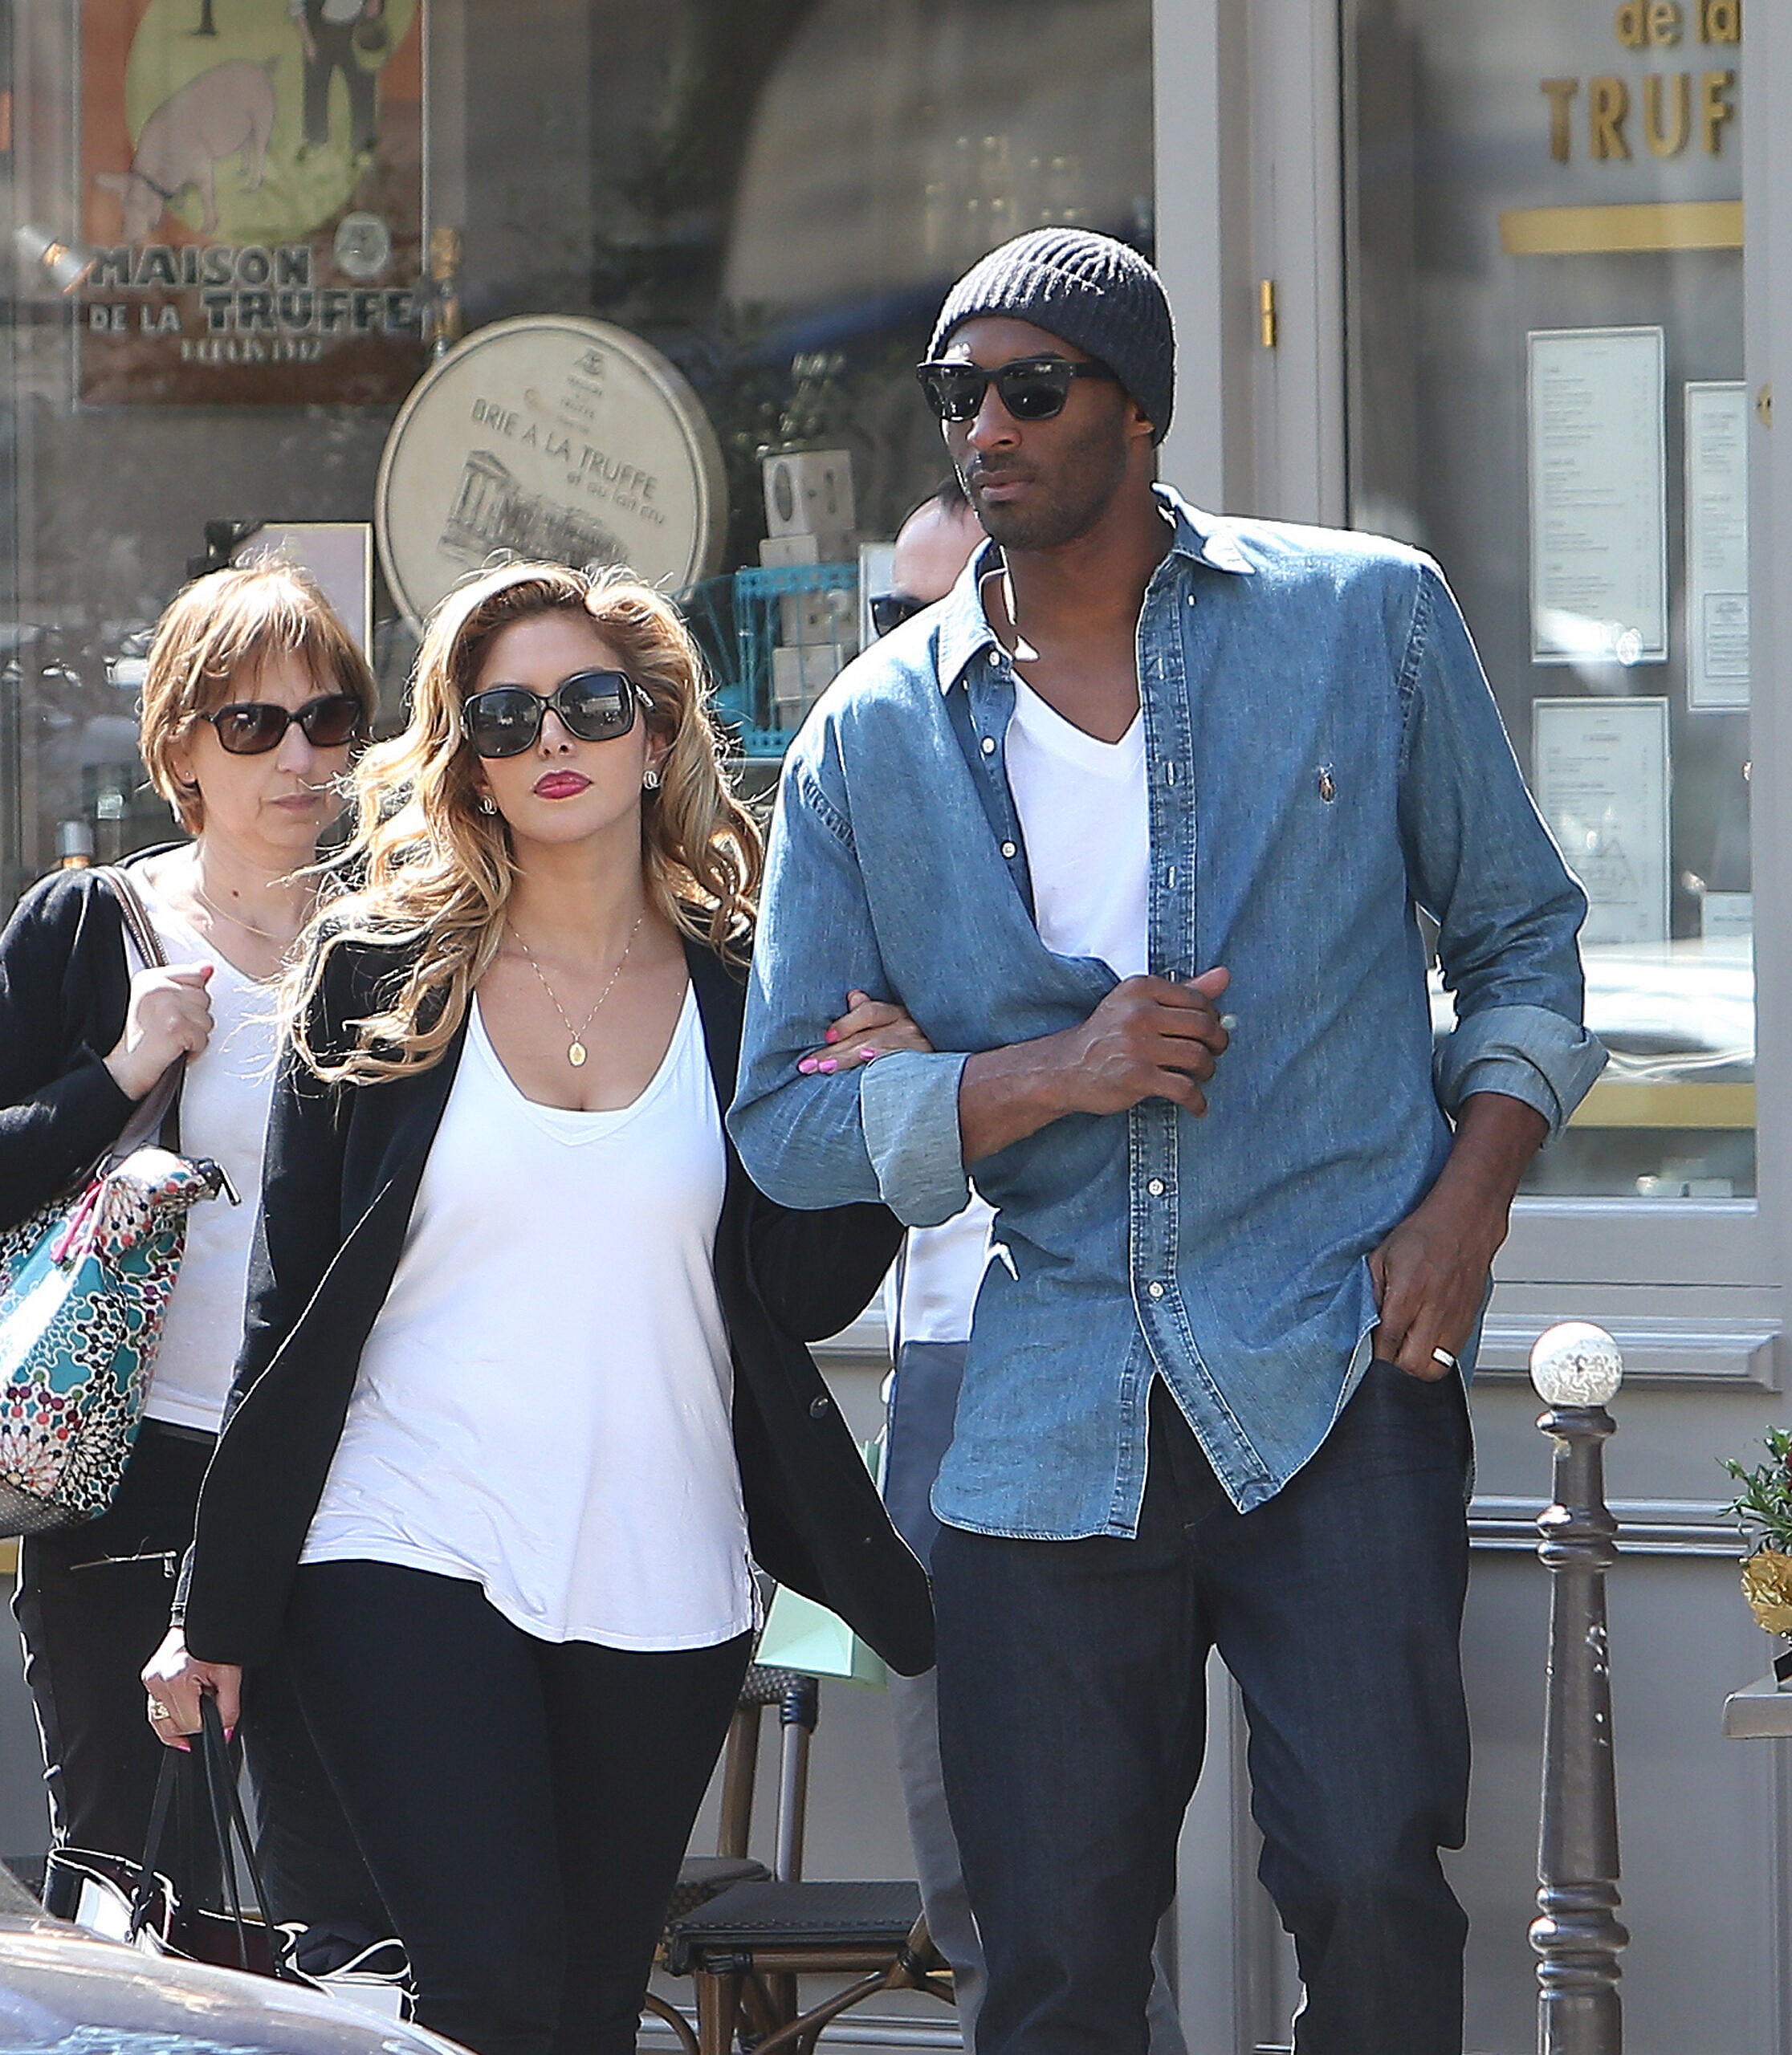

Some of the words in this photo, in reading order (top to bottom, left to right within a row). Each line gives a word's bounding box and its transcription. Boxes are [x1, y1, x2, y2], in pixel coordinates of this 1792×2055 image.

[1615, 0, 1683, 47] de
[1696, 0, 1740, 43] la
[1540, 70, 1735, 164] TRUF
[89, 246, 313, 287] MAISON
[89, 303, 127, 332] DE
[140, 303, 181, 333] LA
[201, 287, 414, 332] TRUFFE
[469, 399, 519, 437] BRIE
[544, 431, 571, 462] LA
[578, 445, 658, 499] TRUFFE
